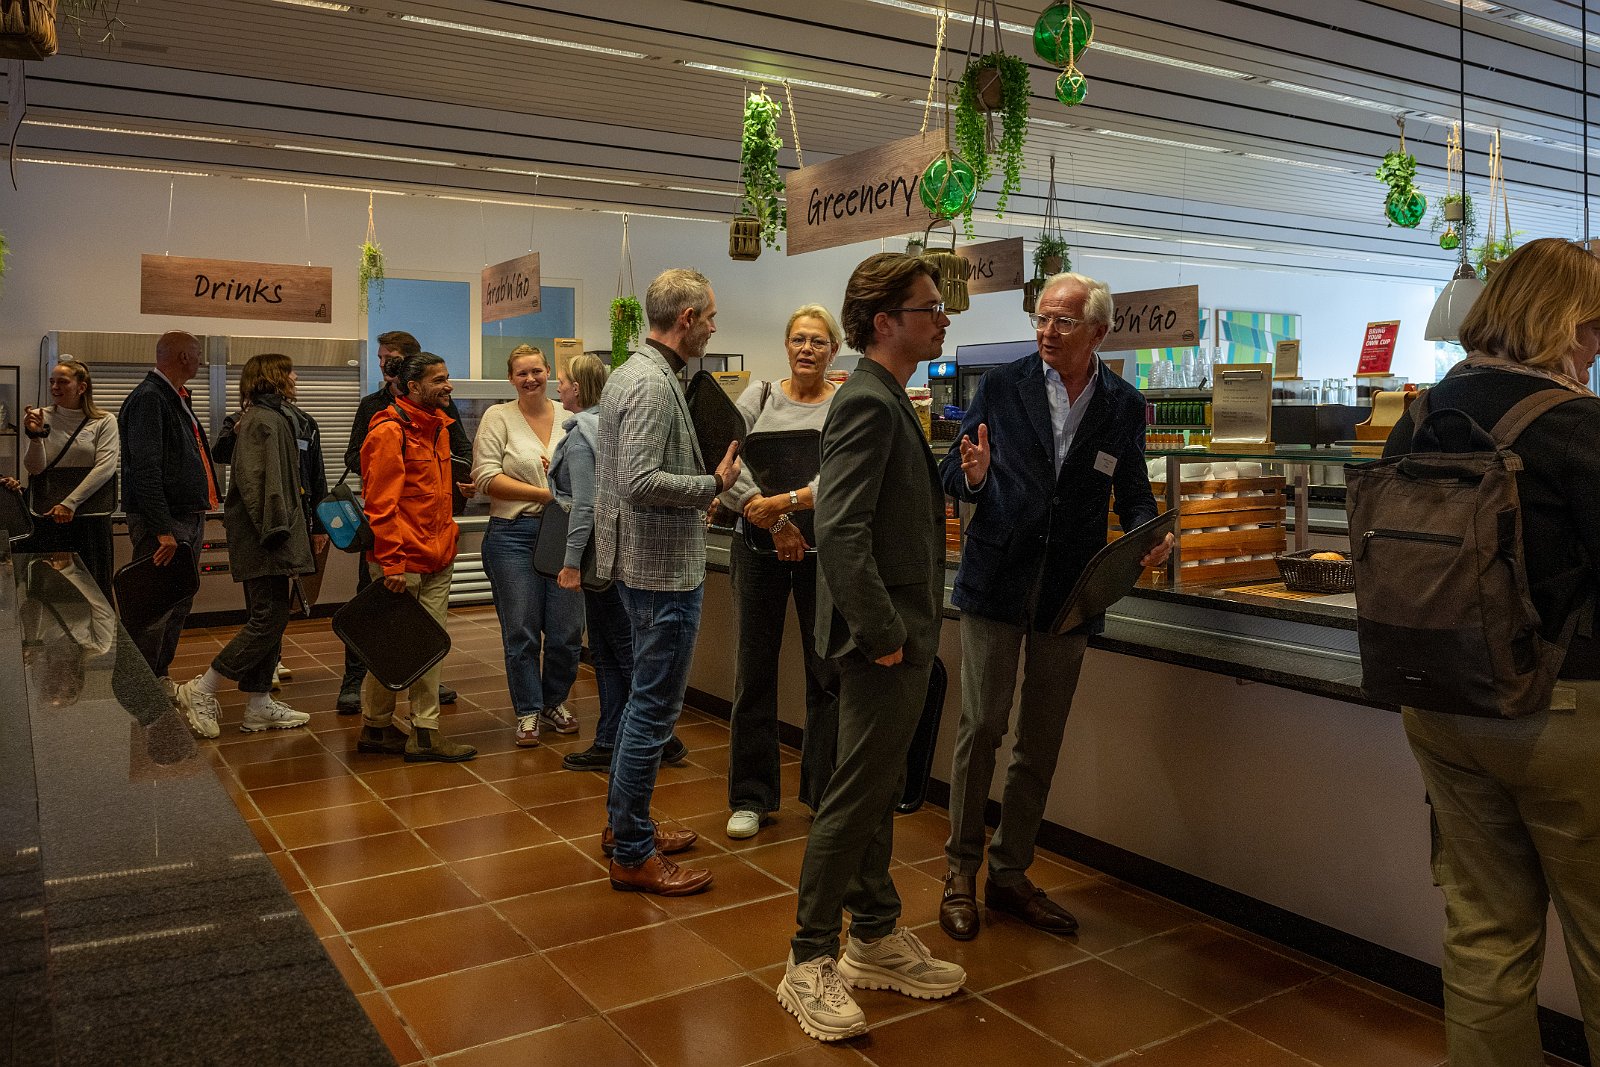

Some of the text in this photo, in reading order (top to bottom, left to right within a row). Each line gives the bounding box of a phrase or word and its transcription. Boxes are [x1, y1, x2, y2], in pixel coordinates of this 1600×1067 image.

[807, 174, 919, 226] Greenery
[968, 258, 994, 280] nks
[194, 274, 283, 304] Drinks
[1379, 338, 1391, 346] CUP
